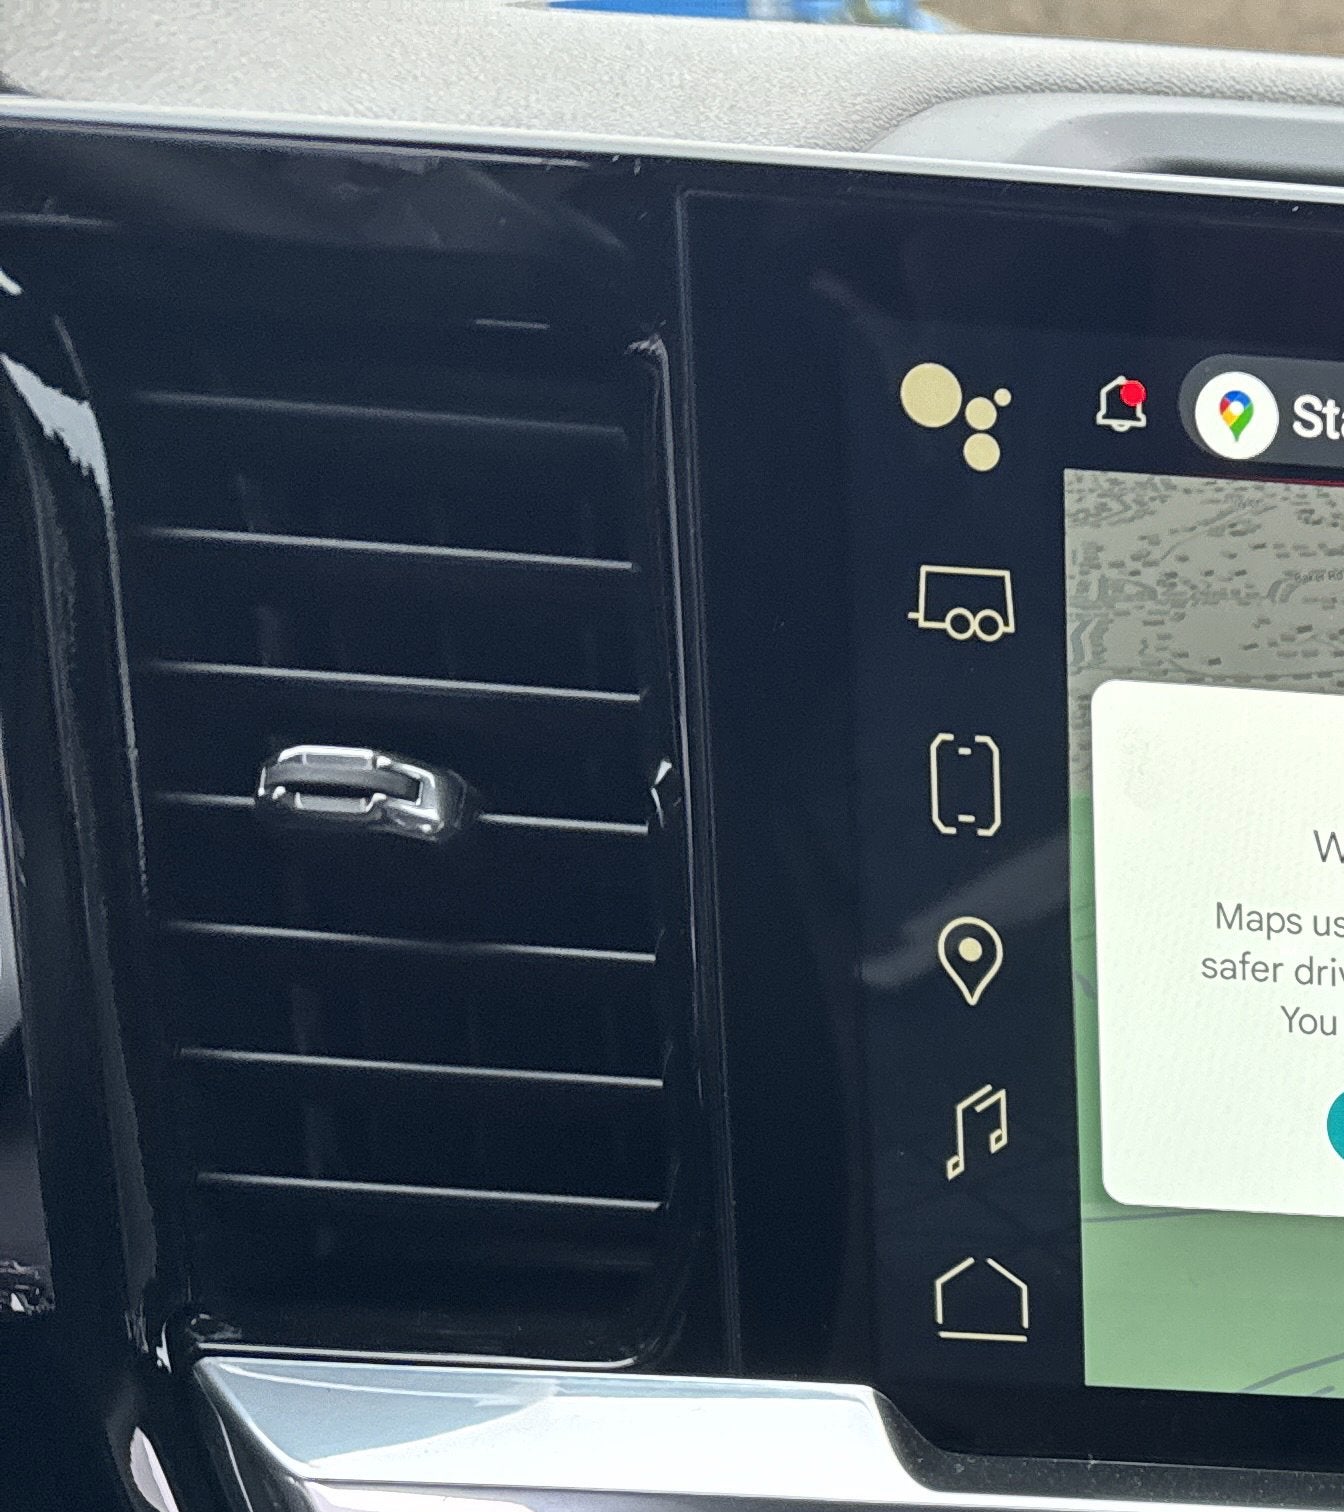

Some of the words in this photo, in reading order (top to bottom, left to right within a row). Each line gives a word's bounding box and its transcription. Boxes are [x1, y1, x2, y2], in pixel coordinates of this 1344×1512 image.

[1328, 570, 1344, 582] Rd
[1216, 901, 1303, 940] Maps
[1201, 951, 1284, 982] safer
[1280, 1005, 1337, 1036] You
